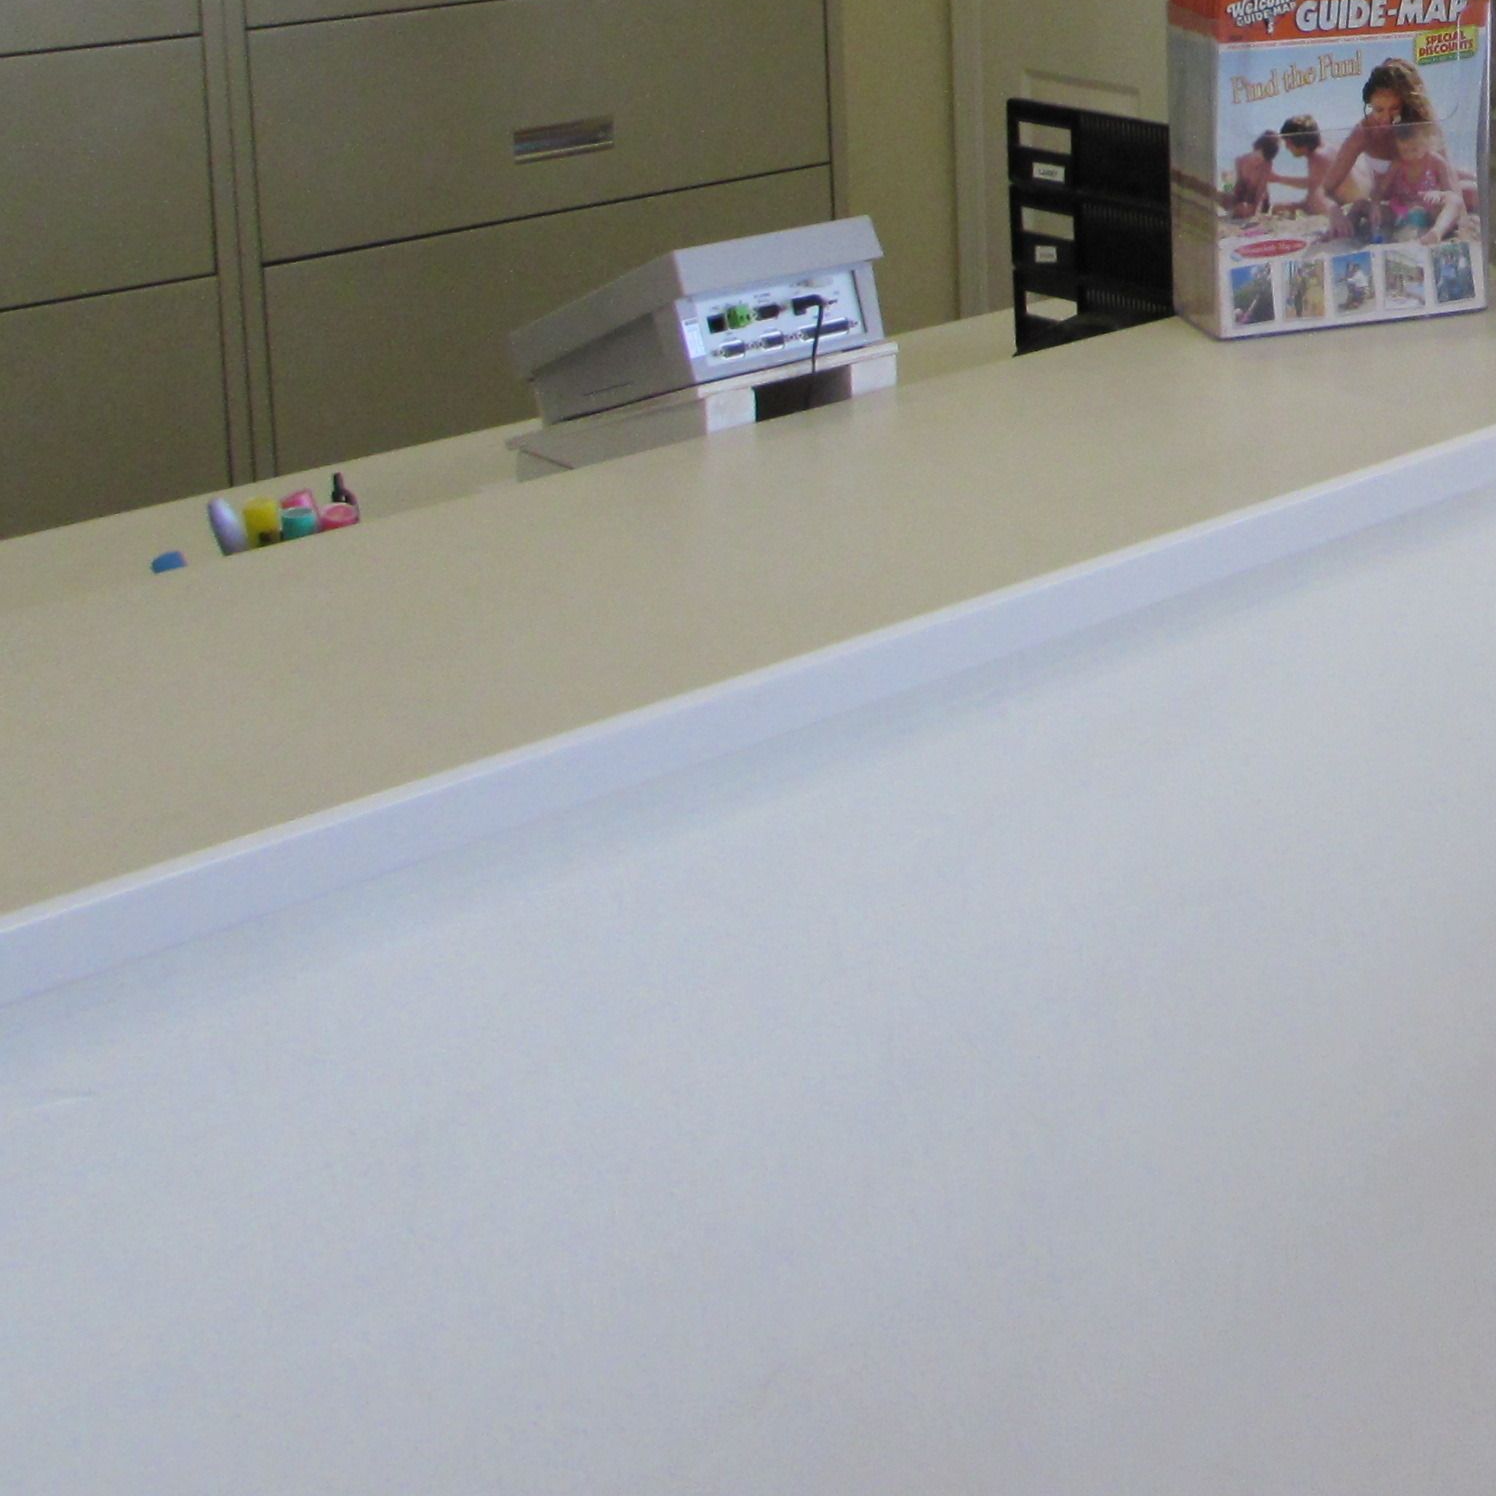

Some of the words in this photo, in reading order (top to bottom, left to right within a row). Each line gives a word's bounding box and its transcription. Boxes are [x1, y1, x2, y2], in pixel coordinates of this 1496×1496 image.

[1424, 29, 1467, 46] SPECIAL
[1418, 38, 1474, 56] DISCOUNTS
[1230, 68, 1280, 105] Find
[1282, 62, 1317, 93] the
